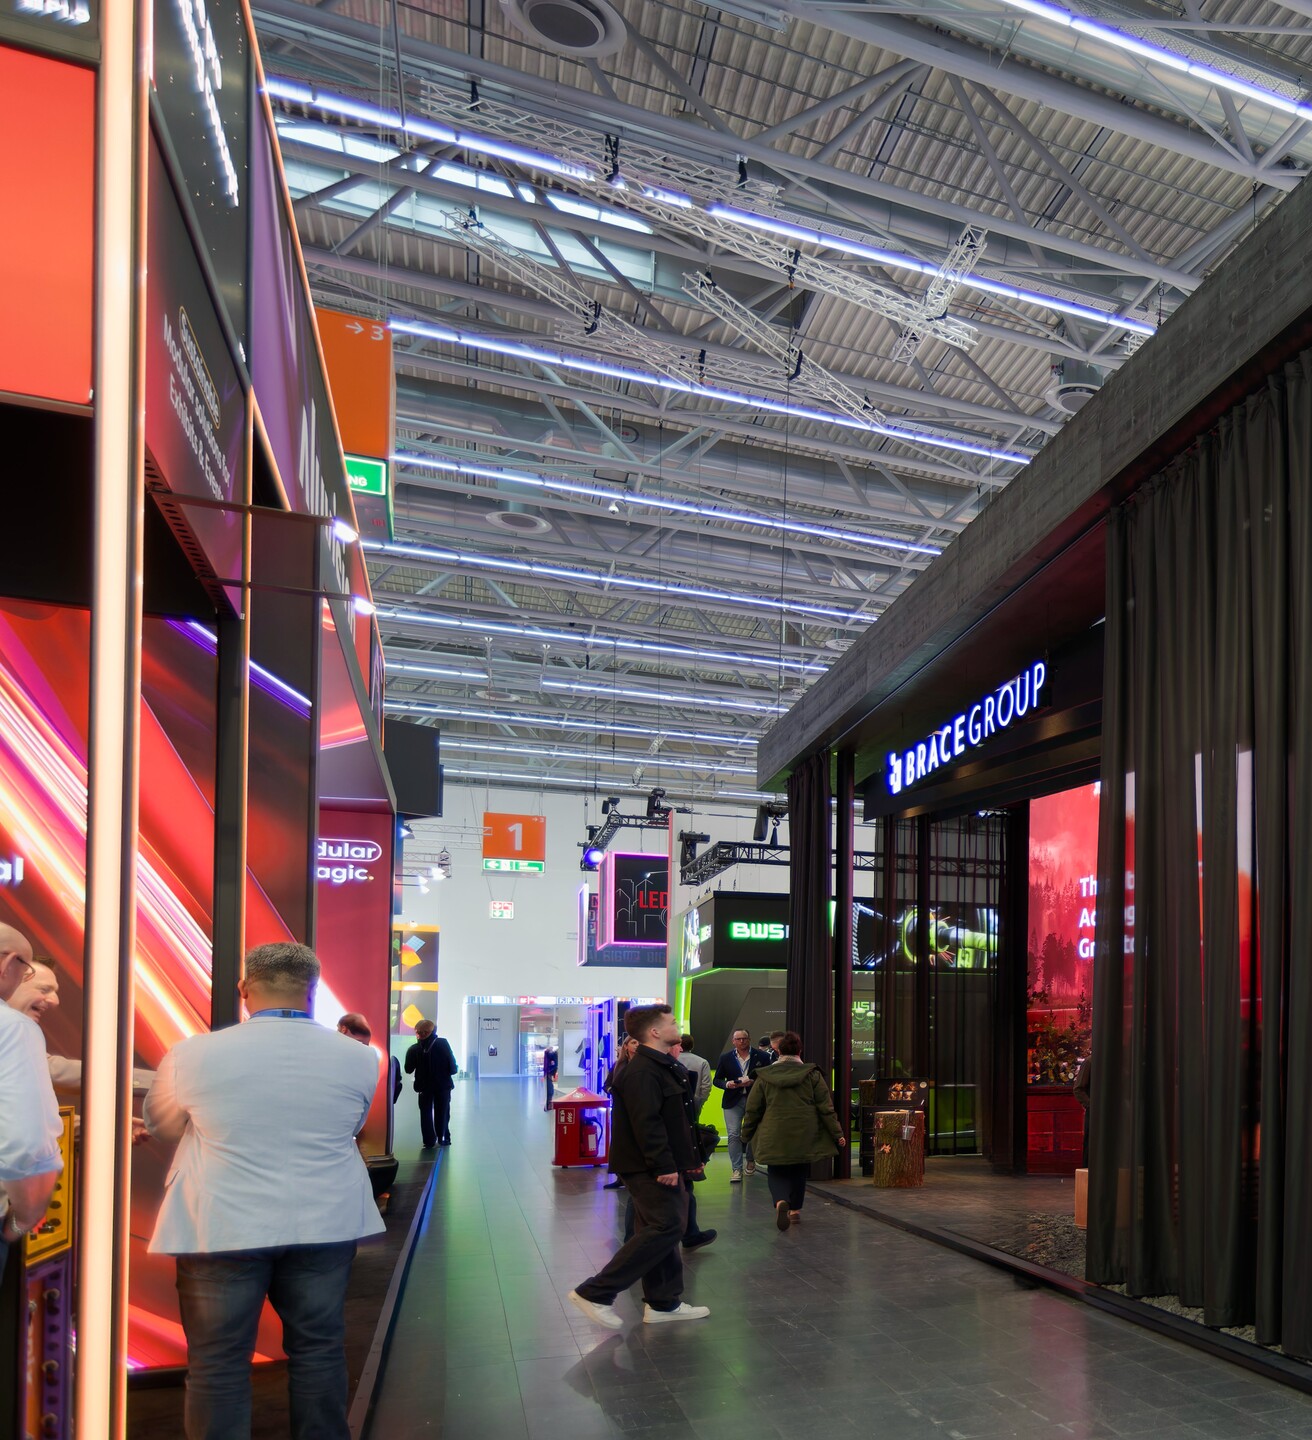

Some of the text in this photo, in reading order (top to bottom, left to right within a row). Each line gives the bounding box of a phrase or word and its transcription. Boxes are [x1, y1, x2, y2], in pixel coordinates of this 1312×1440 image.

[181, 313, 219, 423] Sustainable
[371, 325, 385, 341] 3
[163, 313, 195, 404] Modular
[222, 454, 231, 487] for
[170, 371, 198, 455] Exhibits
[507, 822, 523, 851] 1
